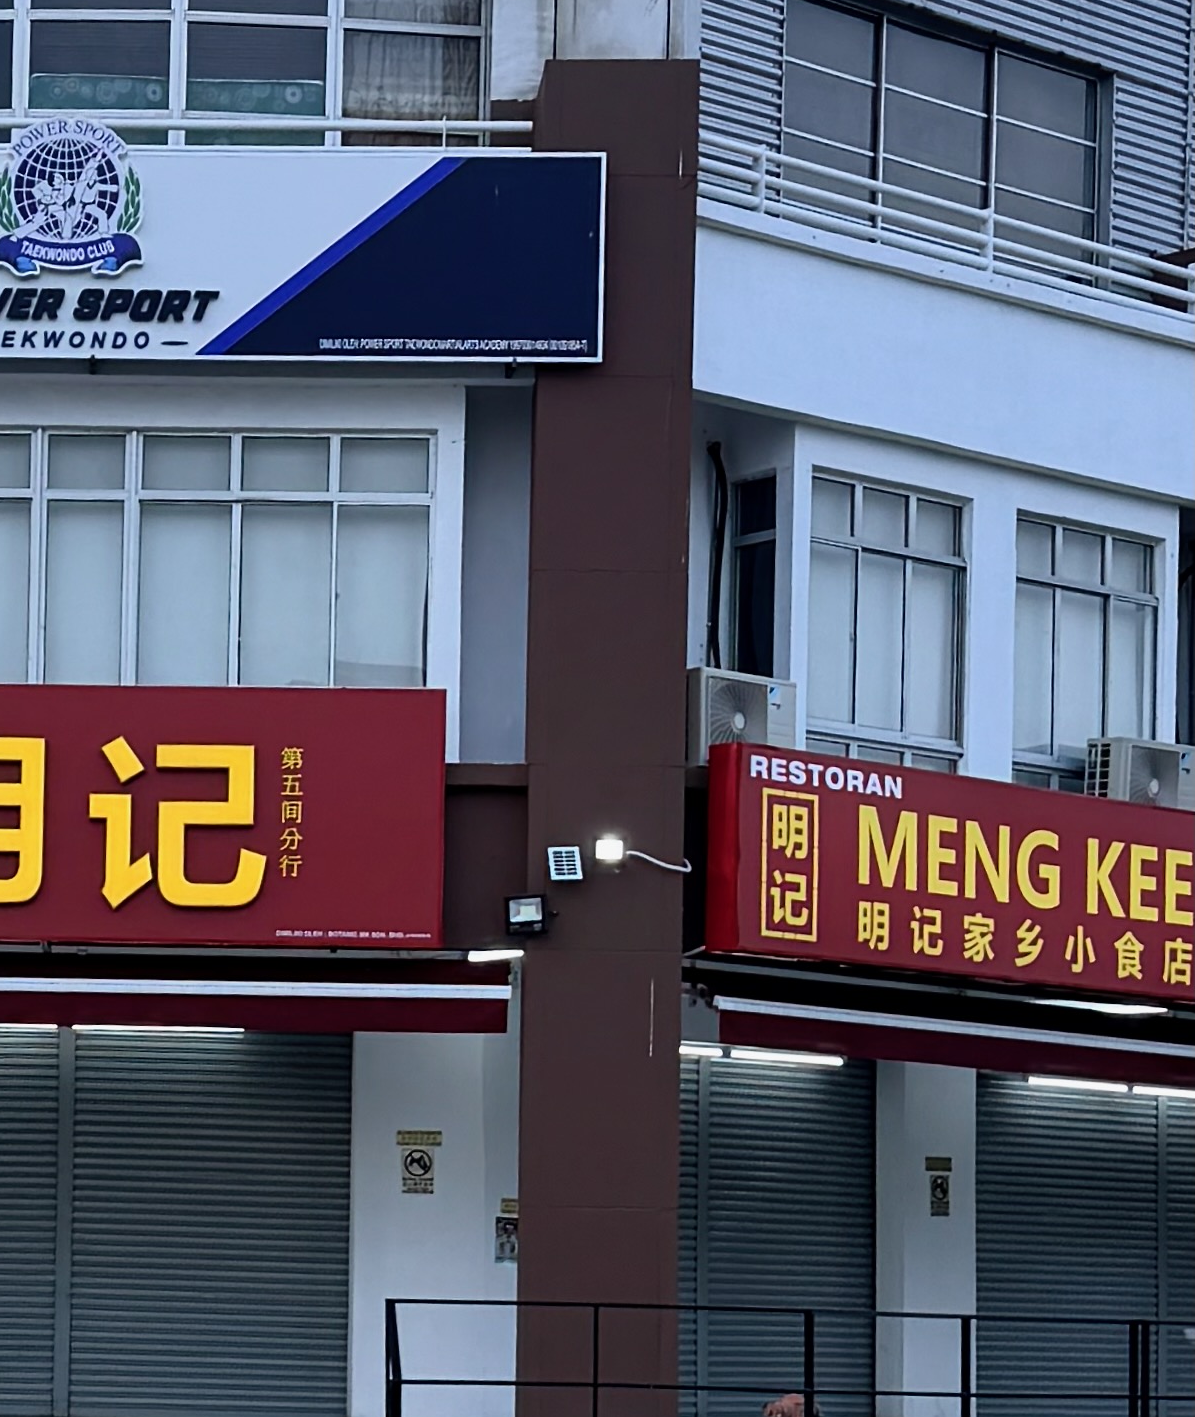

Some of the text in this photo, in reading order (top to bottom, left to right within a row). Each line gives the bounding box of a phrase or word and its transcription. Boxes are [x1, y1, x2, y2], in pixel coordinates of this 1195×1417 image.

[12, 120, 126, 157] POWER SPORT
[20, 239, 115, 262] TAEKWONDO CLUB
[73, 289, 220, 323] SPORT
[750, 754, 903, 799] RESTORAN
[279, 747, 304, 877] 第五间分行
[770, 803, 809, 928] 明记
[857, 804, 1194, 926] MENG KEE
[857, 900, 1194, 986] 明记家乡小食店
